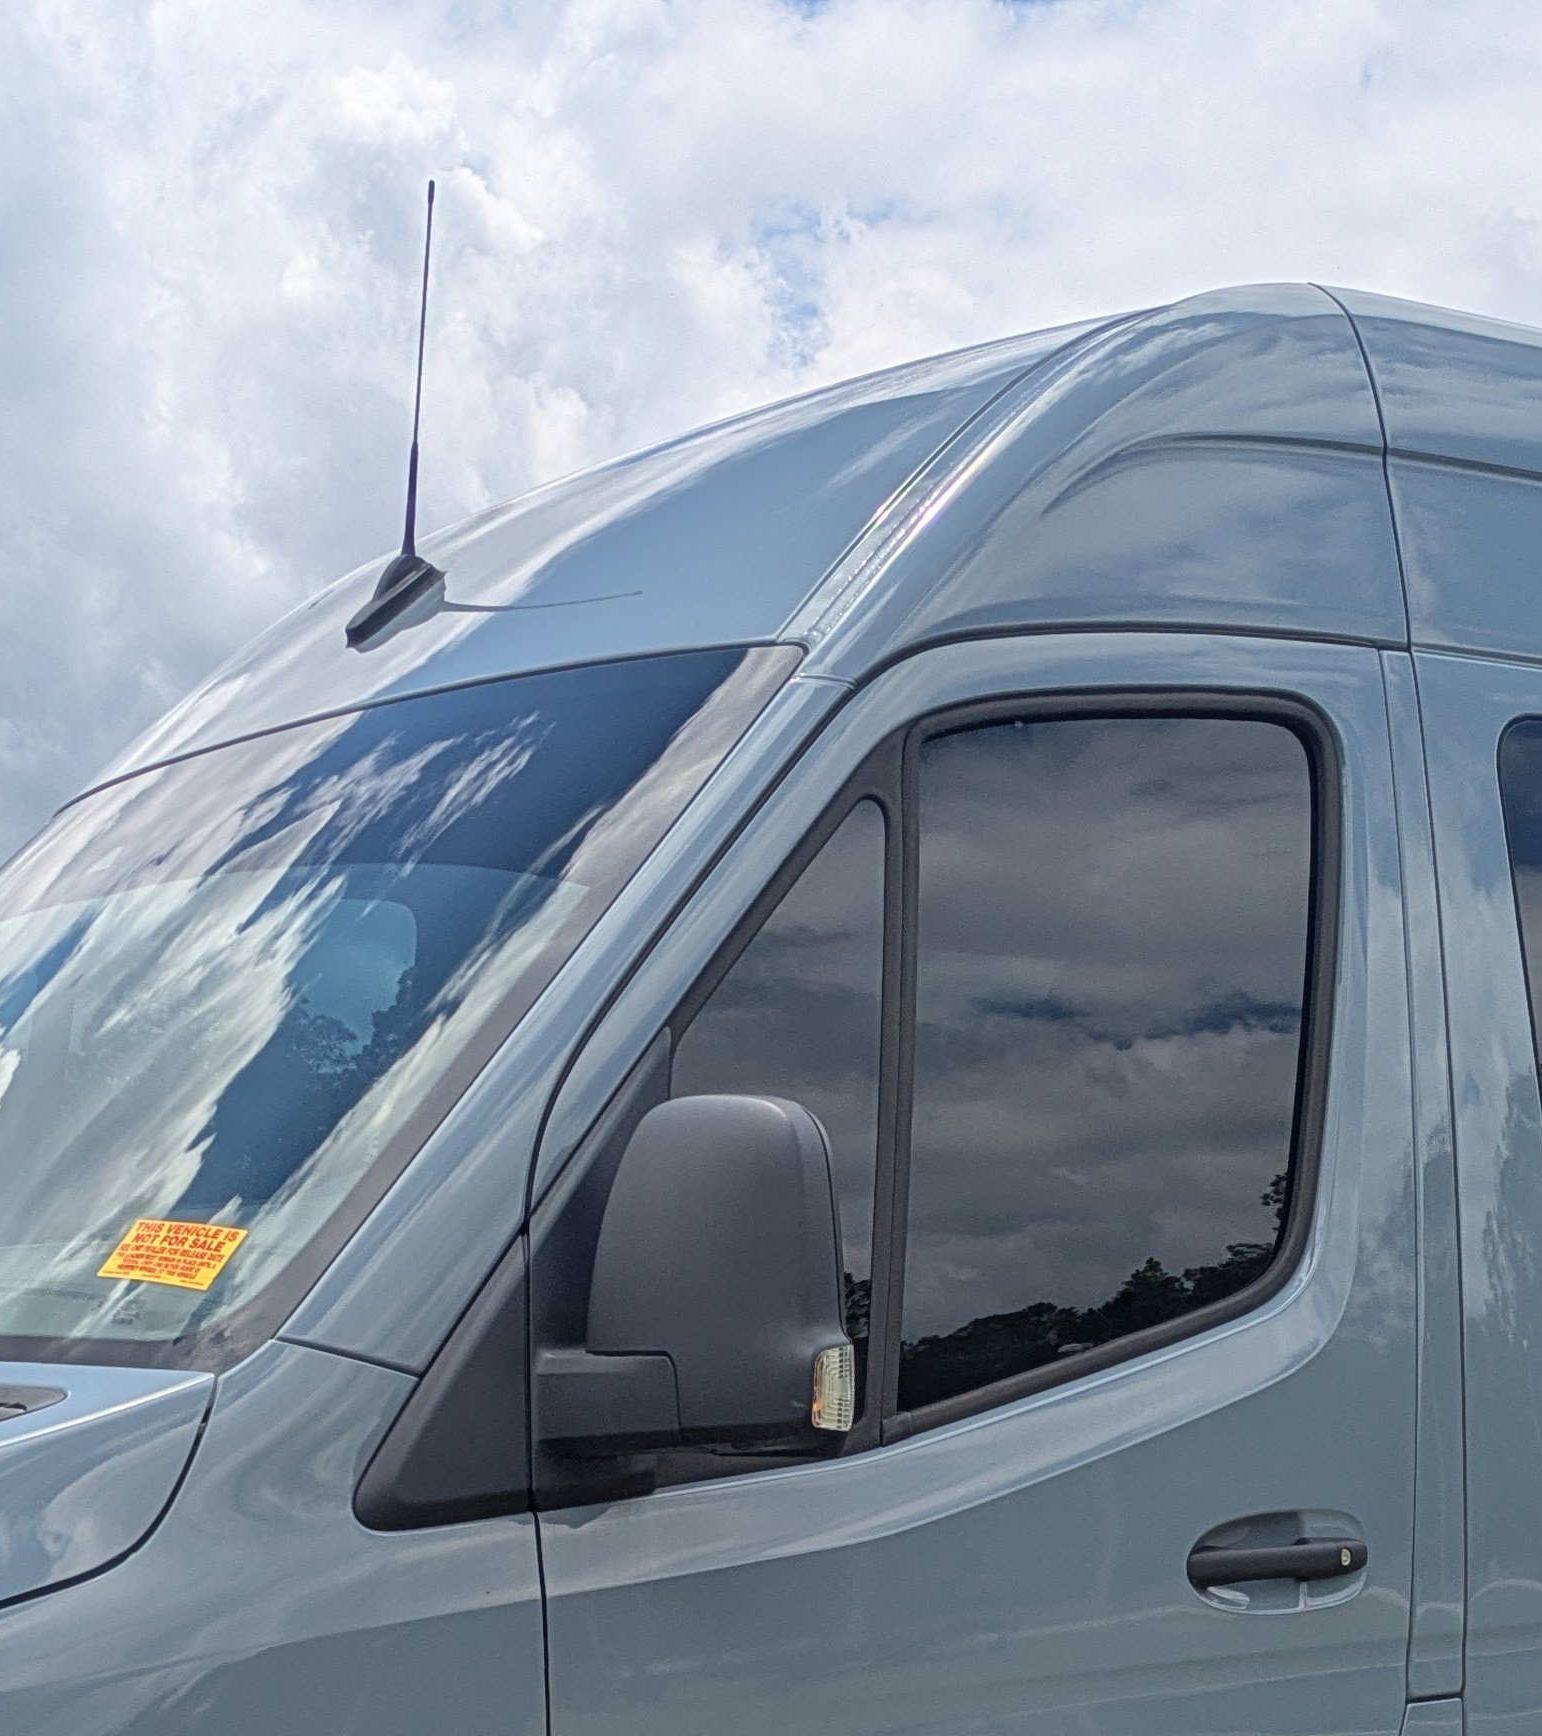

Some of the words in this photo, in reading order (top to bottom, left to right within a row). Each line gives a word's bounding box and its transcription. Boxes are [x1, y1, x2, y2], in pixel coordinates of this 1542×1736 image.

[136, 1222, 165, 1233] THIS
[167, 1224, 224, 1240] VEHICLE
[223, 1230, 240, 1242] IS
[131, 1233, 161, 1244] NOT
[159, 1235, 189, 1248] FOR
[188, 1238, 226, 1252] SALE
